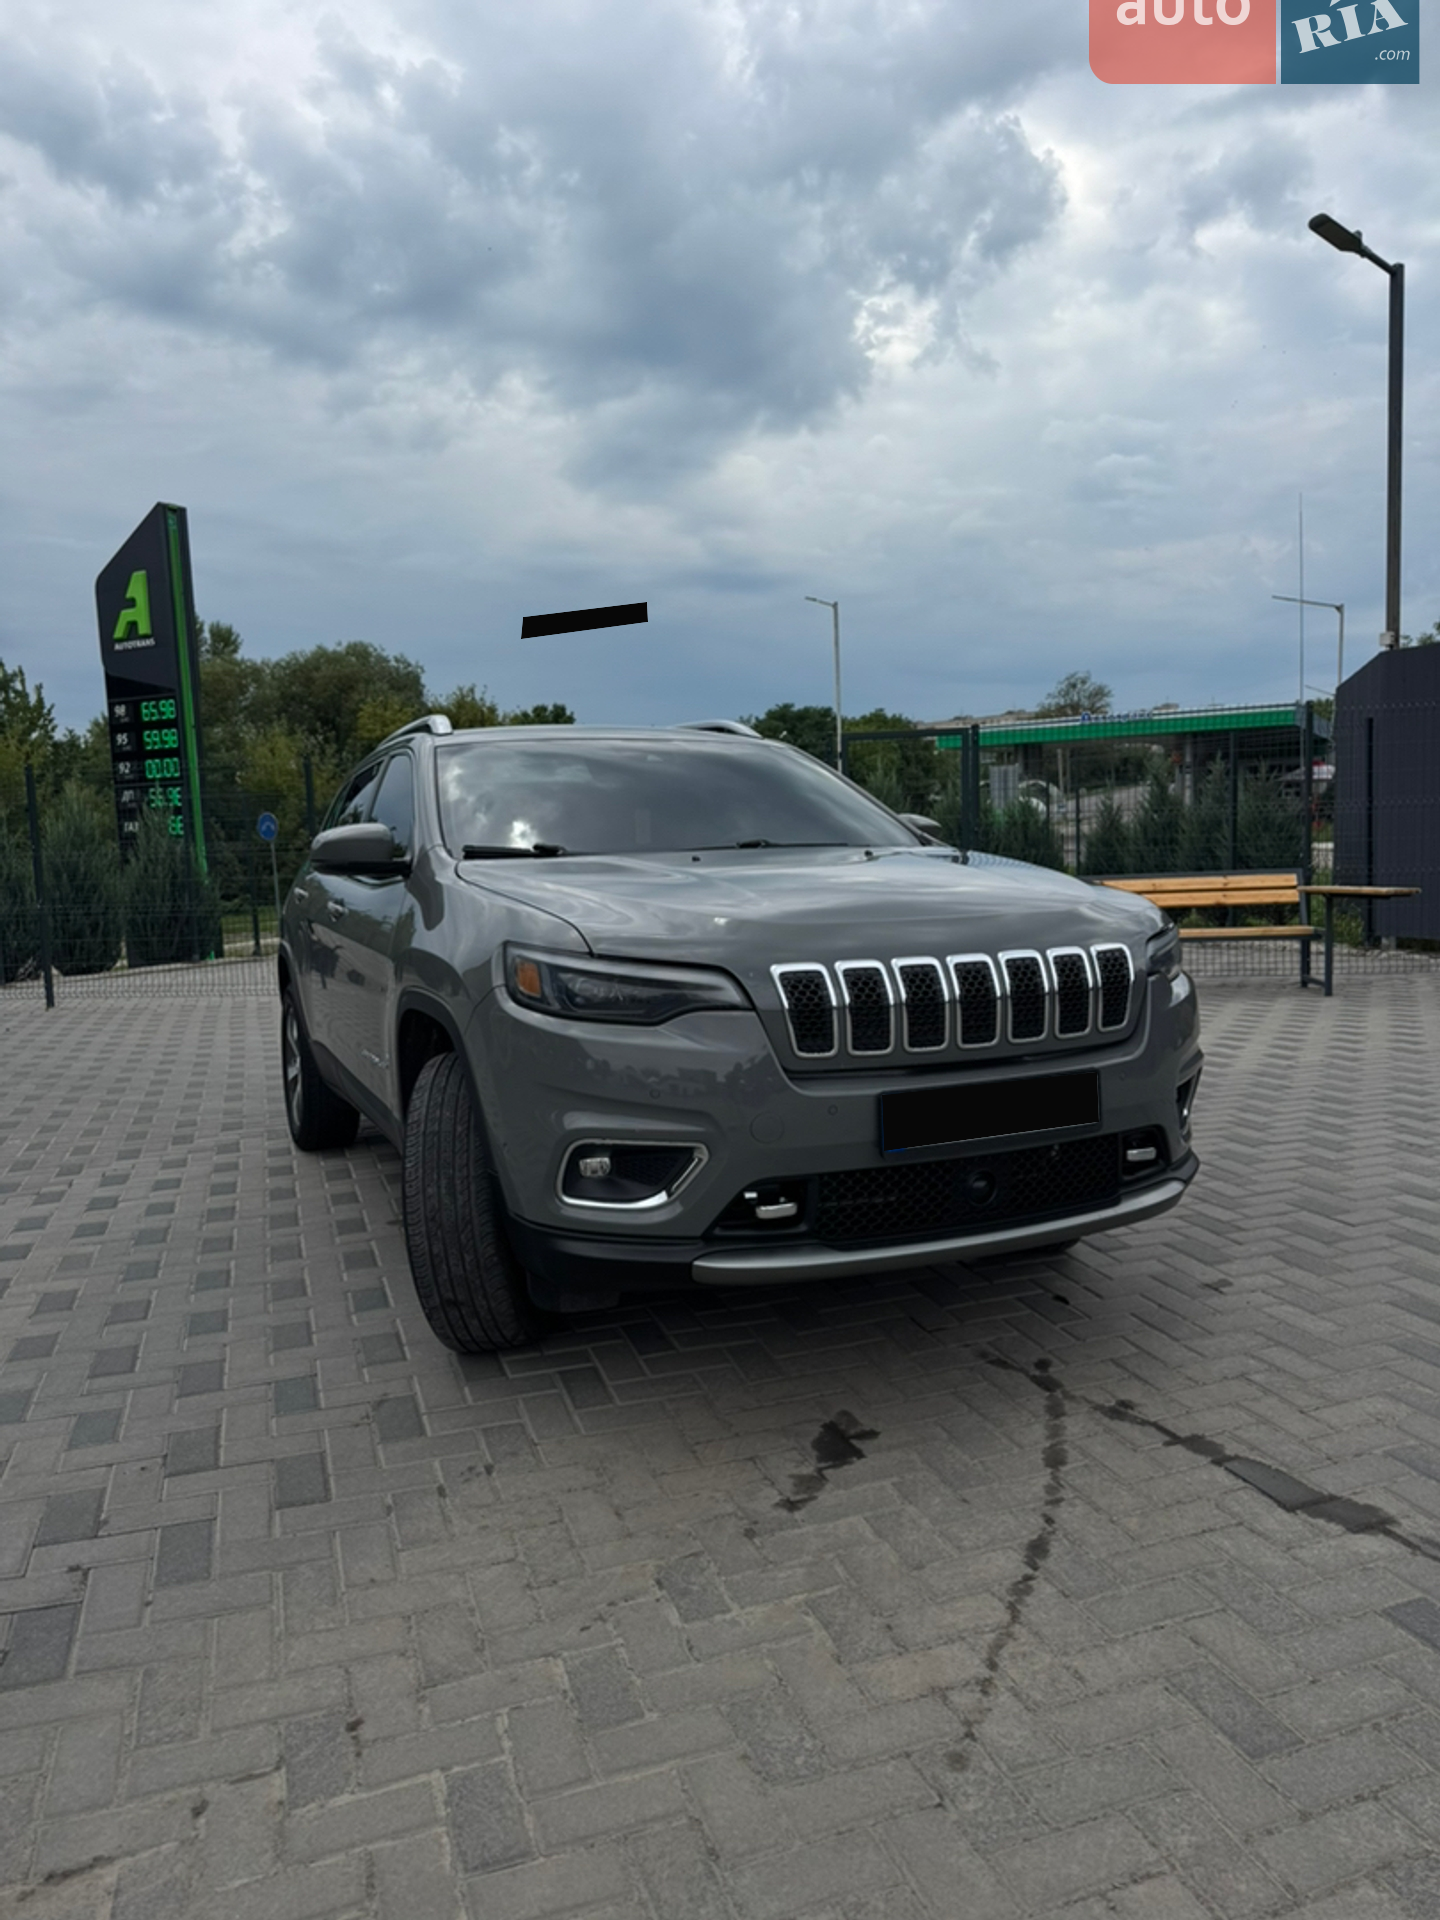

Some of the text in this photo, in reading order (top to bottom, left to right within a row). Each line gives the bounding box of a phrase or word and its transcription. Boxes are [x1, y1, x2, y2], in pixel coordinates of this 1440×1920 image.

[113, 638, 156, 651] AUTOTRANS
[114, 699, 176, 721] 98 65.98
[116, 728, 179, 750] 95 59.98
[119, 761, 131, 775] 92
